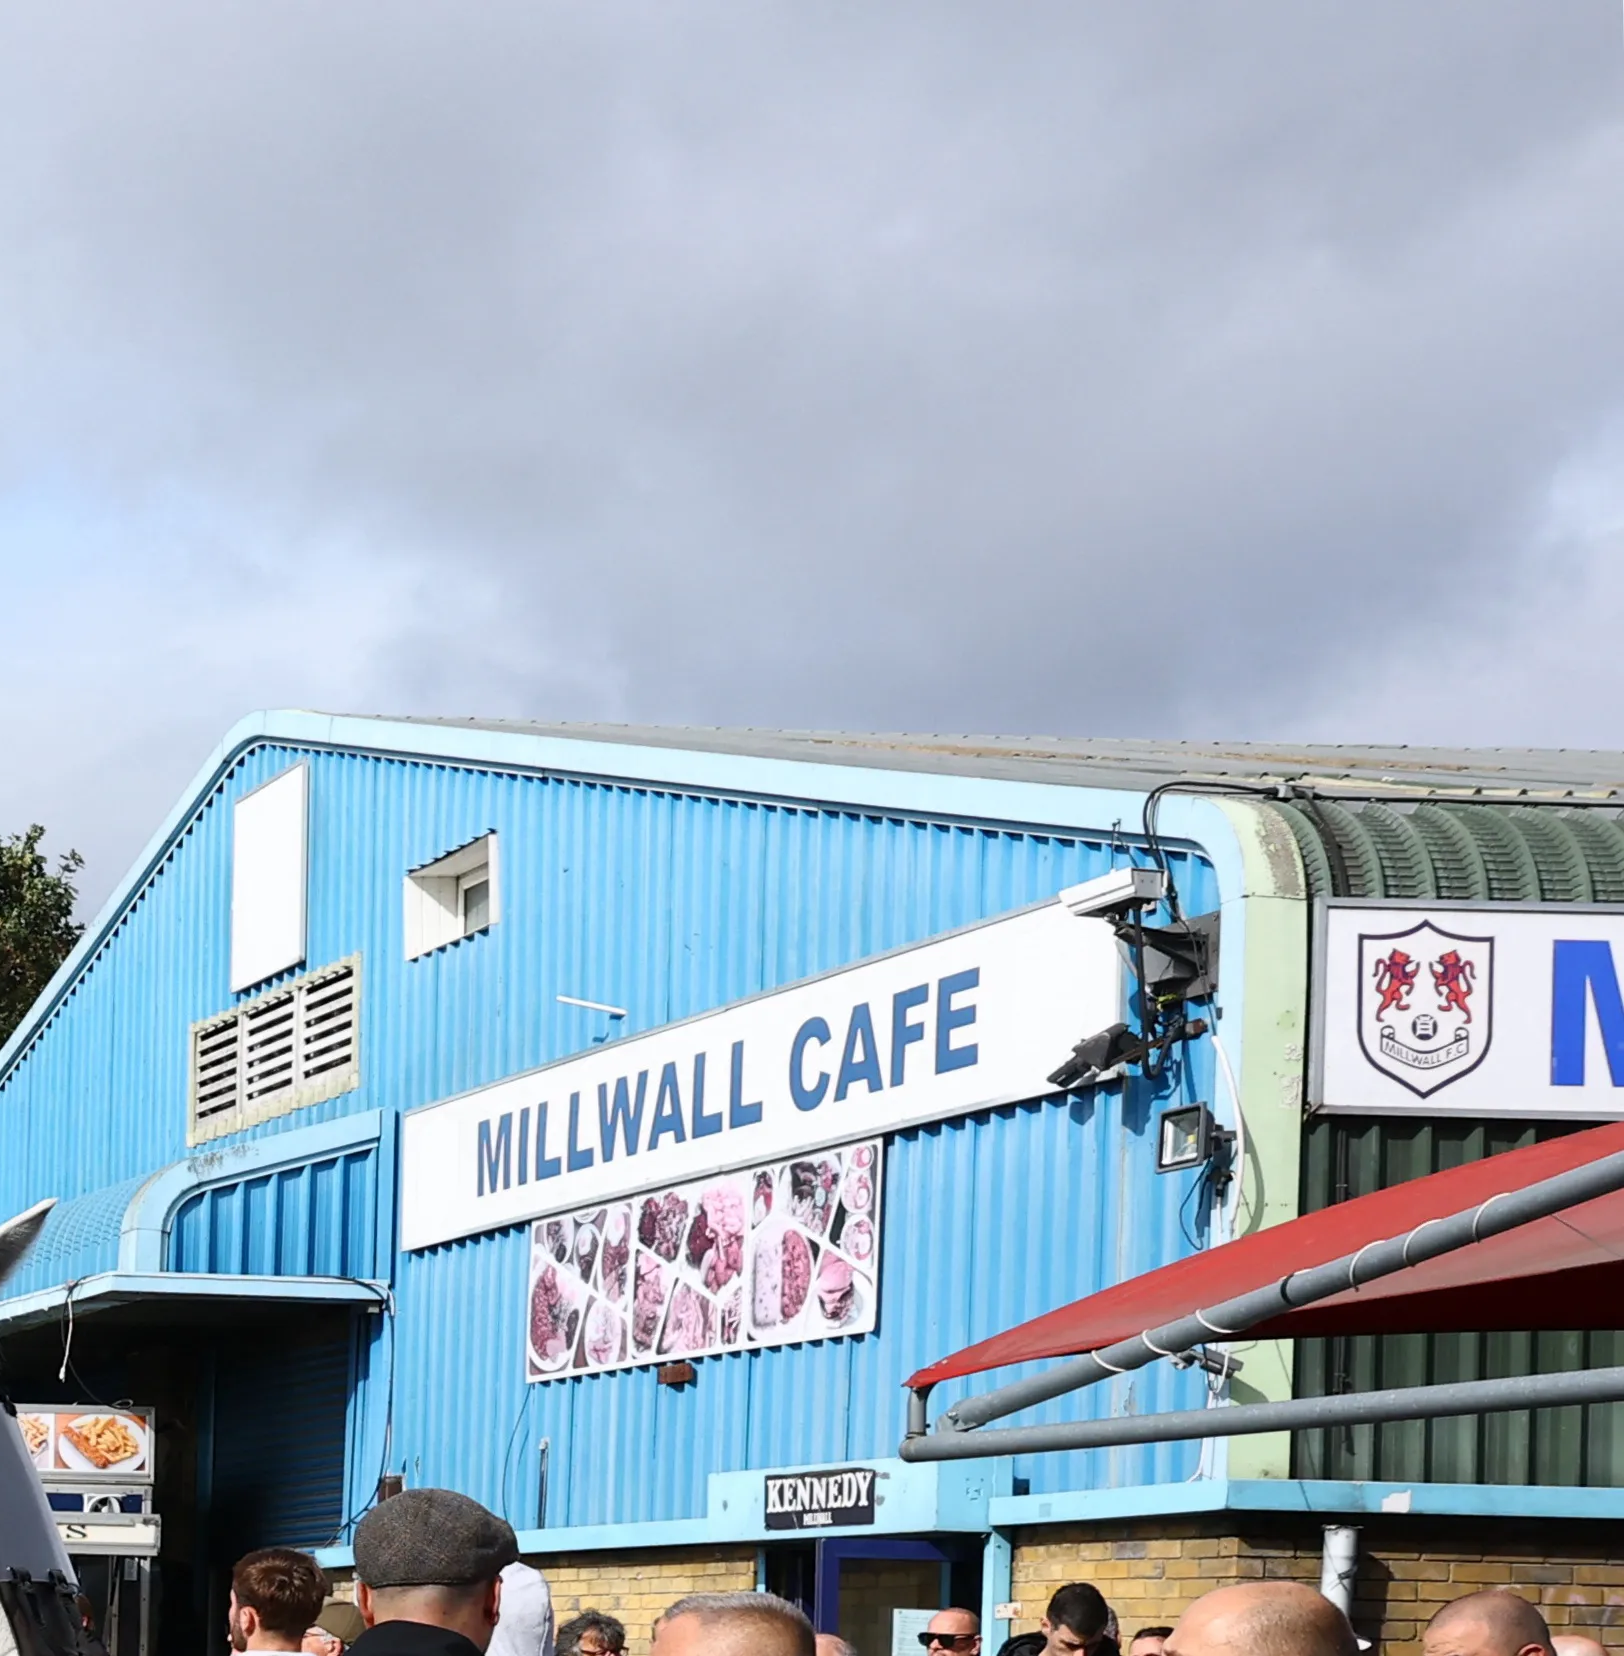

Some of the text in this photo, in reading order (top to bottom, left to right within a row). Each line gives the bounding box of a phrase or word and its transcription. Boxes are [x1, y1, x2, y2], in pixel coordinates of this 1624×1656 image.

[1385, 1041, 1442, 1065] MILLWALL
[477, 967, 980, 1197] MILLWALL CAFE
[766, 1471, 873, 1514] KENNEDY
